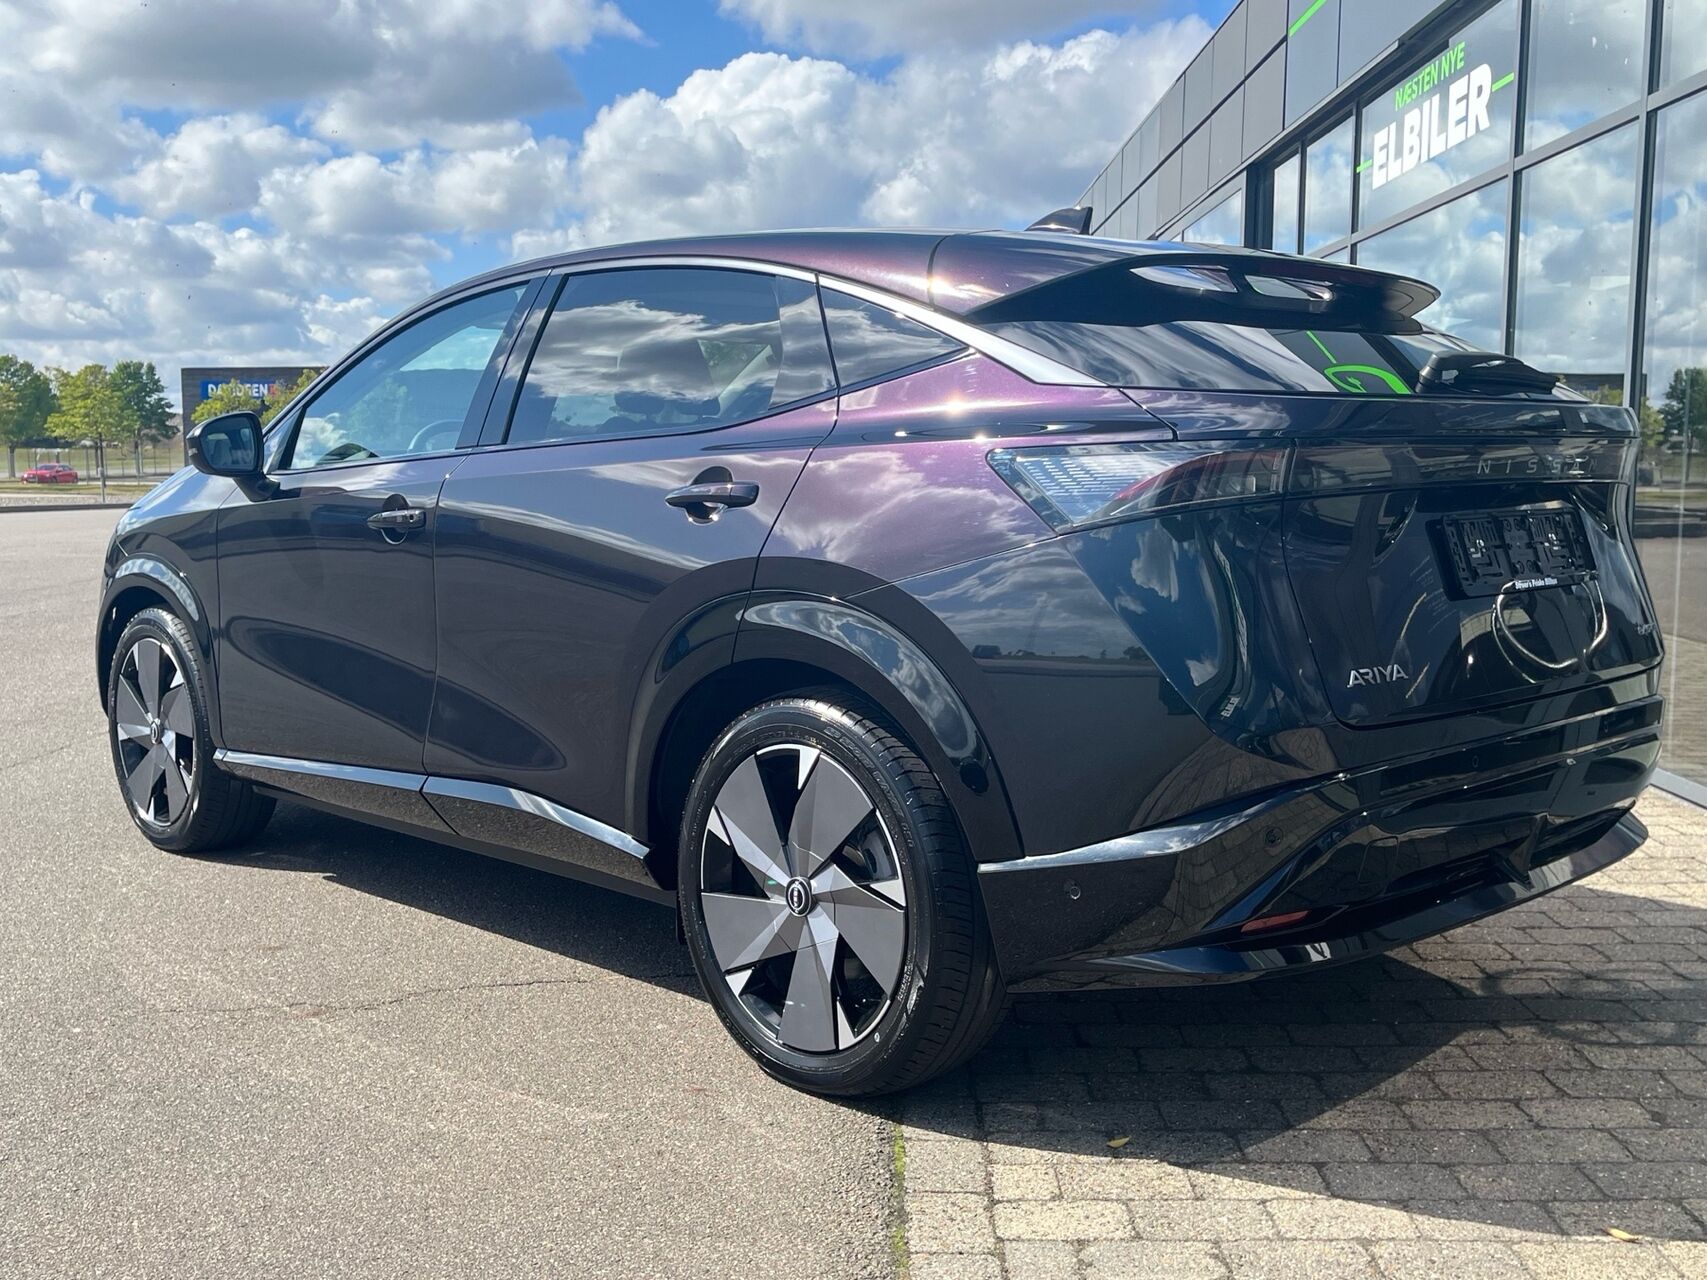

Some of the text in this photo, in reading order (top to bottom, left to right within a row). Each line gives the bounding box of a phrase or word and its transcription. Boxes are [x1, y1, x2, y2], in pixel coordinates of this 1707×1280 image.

[1395, 41, 1466, 112] NÆSTEN NYE
[1372, 63, 1492, 190] ELBILER
[1477, 456, 1599, 475] NISSAN
[1347, 664, 1409, 688] ARIYA
